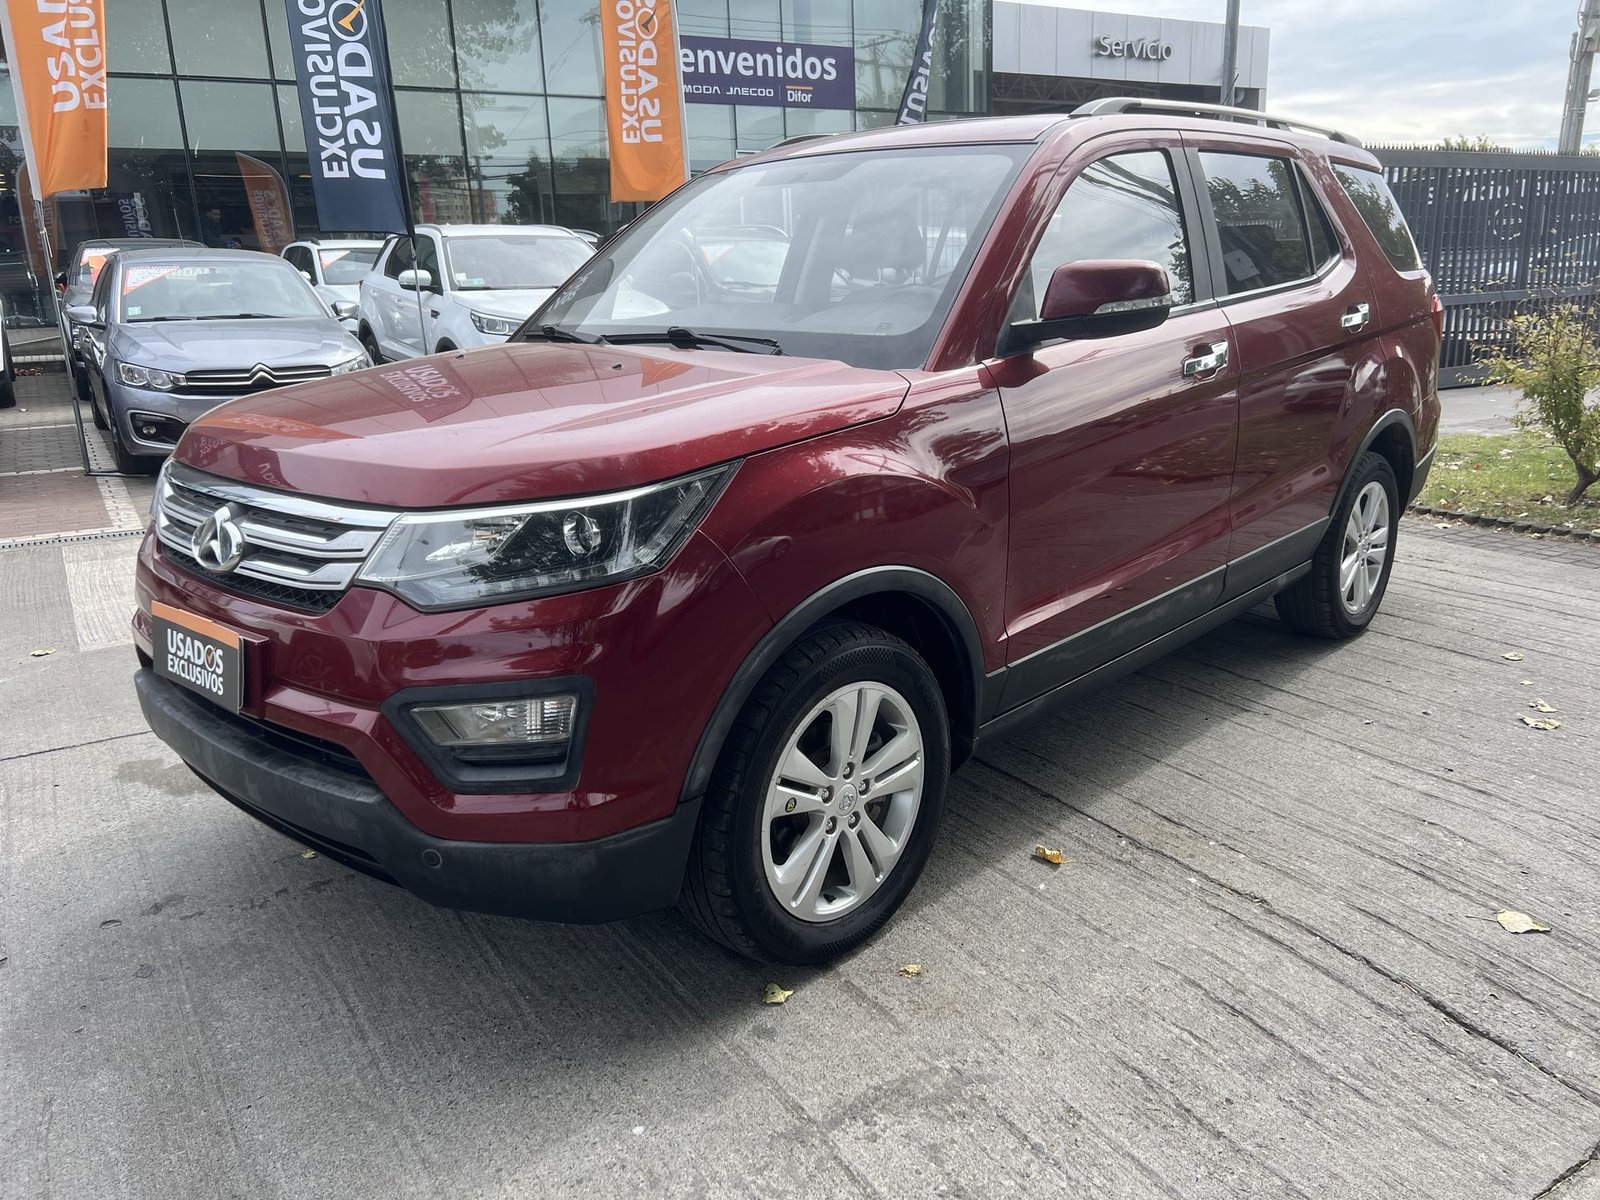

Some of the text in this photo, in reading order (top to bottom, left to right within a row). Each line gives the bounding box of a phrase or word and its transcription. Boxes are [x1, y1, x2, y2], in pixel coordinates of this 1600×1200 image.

[68, 0, 107, 110] EXCLU
[1098, 34, 1174, 61] Servicio
[726, 86, 774, 97] JAECOO
[787, 90, 812, 103] Difor
[167, 628, 224, 675] USADOS
[167, 653, 224, 696] EXCLUSIVOS
